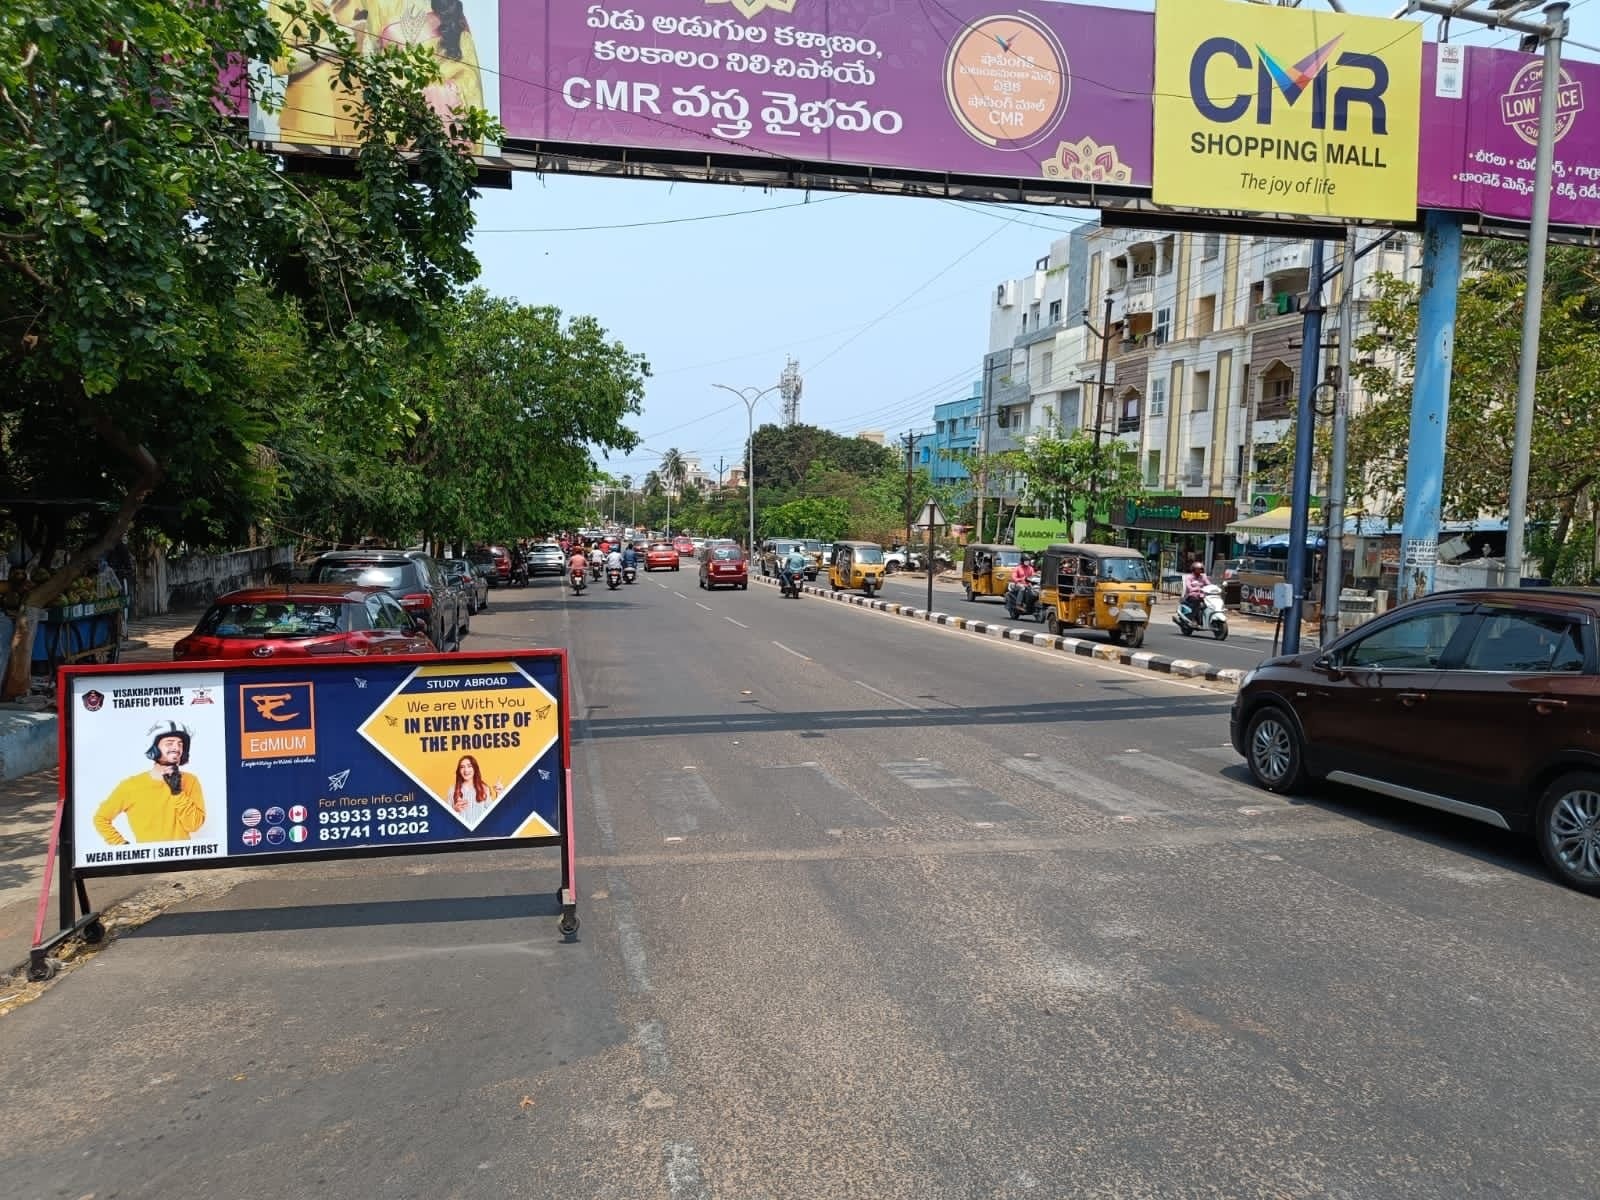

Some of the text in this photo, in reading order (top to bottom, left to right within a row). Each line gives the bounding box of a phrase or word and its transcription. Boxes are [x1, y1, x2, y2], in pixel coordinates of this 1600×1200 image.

[586, 5, 645, 31] ఏడు
[652, 15, 767, 44] అడుగుల
[594, 40, 876, 86] కలకాలం నిలిచిపోయే
[1189, 33, 1390, 136] CMR
[562, 77, 903, 139] CMR వస్త్ర వైభవం
[1506, 97, 1536, 118] LOW
[989, 110, 1024, 127] CMR
[1191, 131, 1387, 168] SHOPPING MALL
[1240, 172, 1336, 195] The joy of life
[112, 686, 181, 698] VISAKHAPATNAM
[427, 677, 508, 689] STUDY ABROAD
[112, 698, 150, 709] TRAFFIC
[153, 695, 184, 707] POLICE
[408, 697, 525, 712] We are With You
[404, 711, 531, 734] IN EVERY STEP OF
[250, 736, 306, 752] EdMIUM
[419, 731, 520, 752] THE PROCESS
[319, 792, 414, 808] For More Info Call
[319, 805, 429, 824] 93933 93343
[319, 821, 429, 841] 83741 10202
[85, 844, 218, 863] WEAR HELMET SAFETY FIRST
